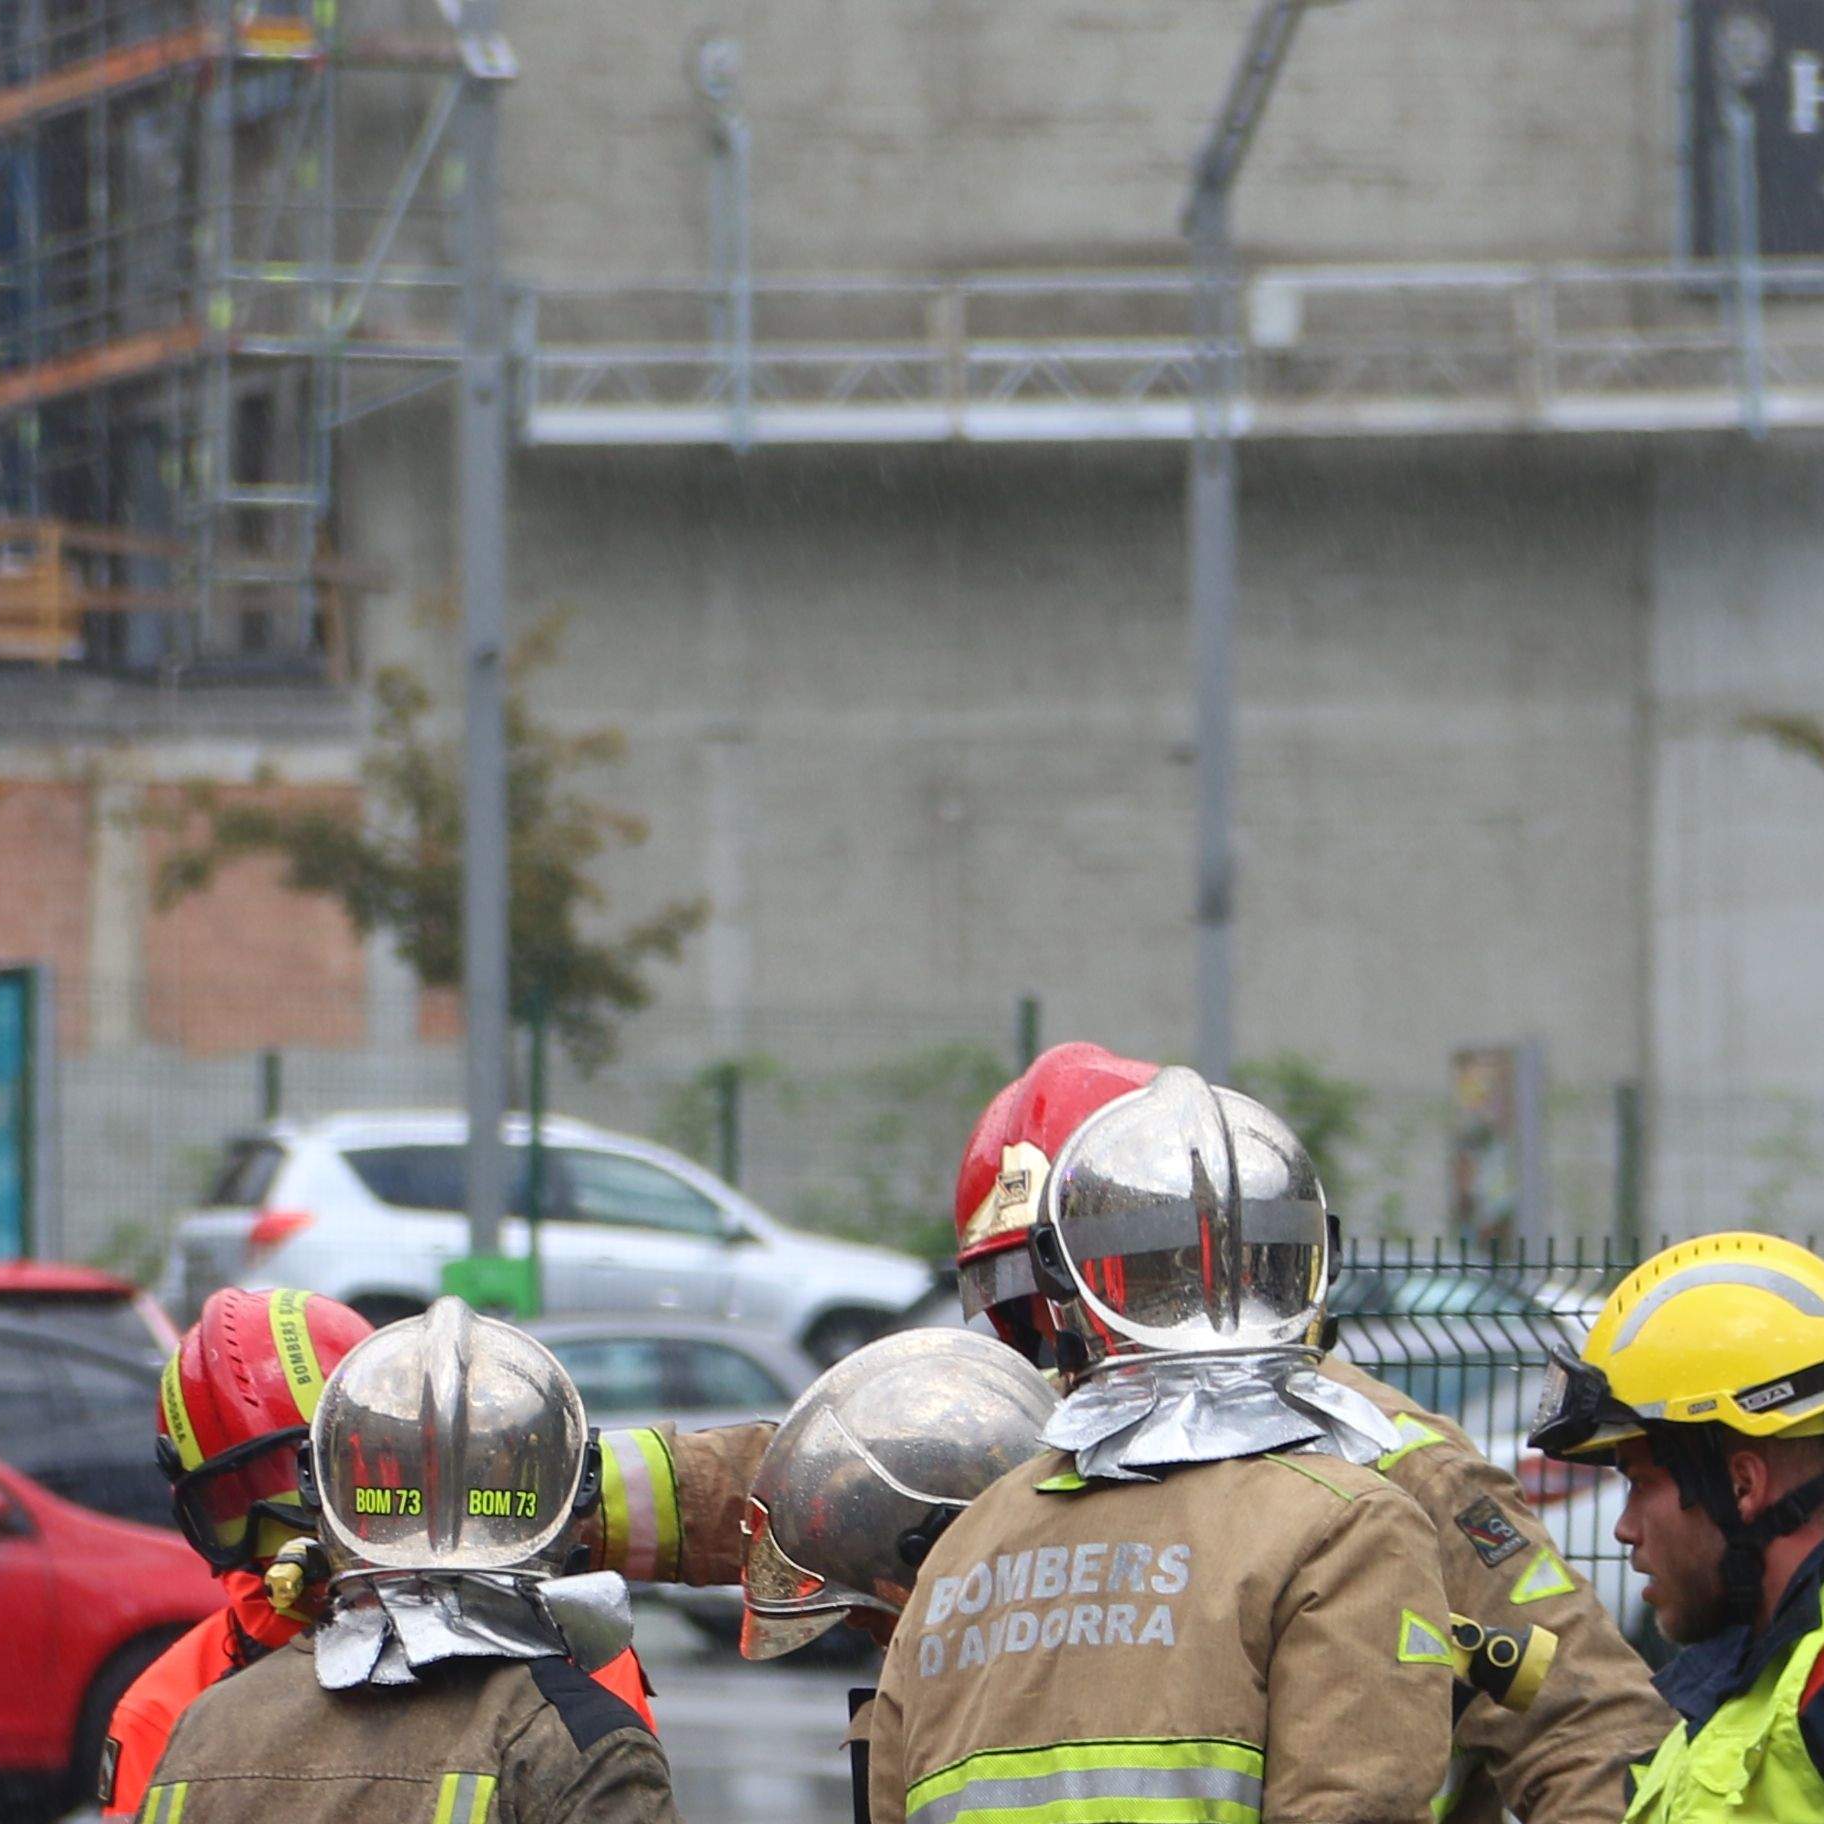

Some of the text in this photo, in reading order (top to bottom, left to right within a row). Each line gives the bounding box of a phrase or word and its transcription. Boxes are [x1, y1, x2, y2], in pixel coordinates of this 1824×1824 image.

[279, 1319, 312, 1386] BOMBERS
[355, 1487, 423, 1516] BOM 73
[468, 1489, 538, 1518] BOM 73
[923, 1541, 1192, 1627] BOMBERS
[918, 1603, 1176, 1678] D'ANDORRA
